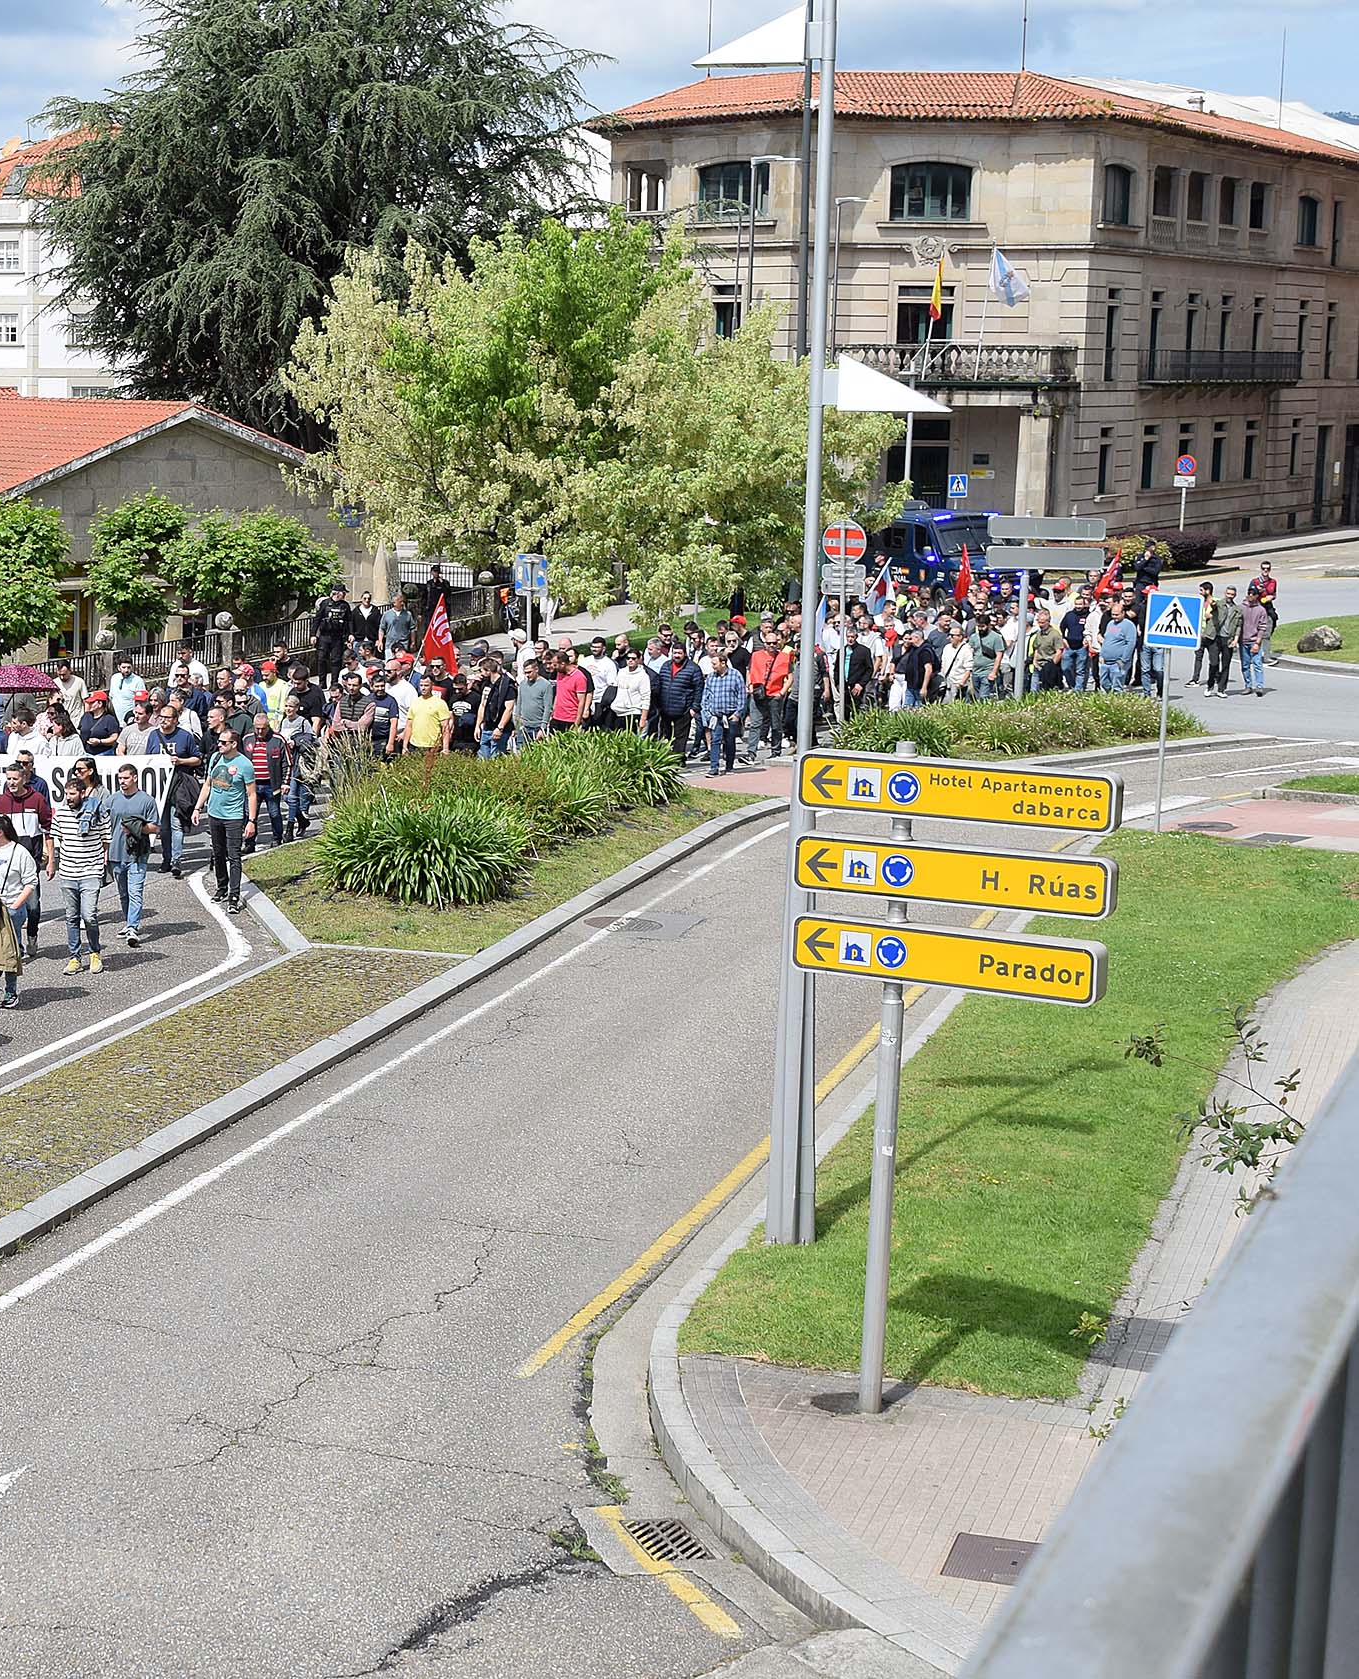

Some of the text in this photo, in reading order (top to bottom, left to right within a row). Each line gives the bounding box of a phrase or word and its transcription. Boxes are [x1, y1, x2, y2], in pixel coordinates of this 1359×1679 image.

[929, 773, 1102, 799] Hotel Apartamentos
[1012, 801, 1100, 822] dabarca
[981, 870, 1098, 900] H. Rúas
[979, 954, 1085, 986] Parador
